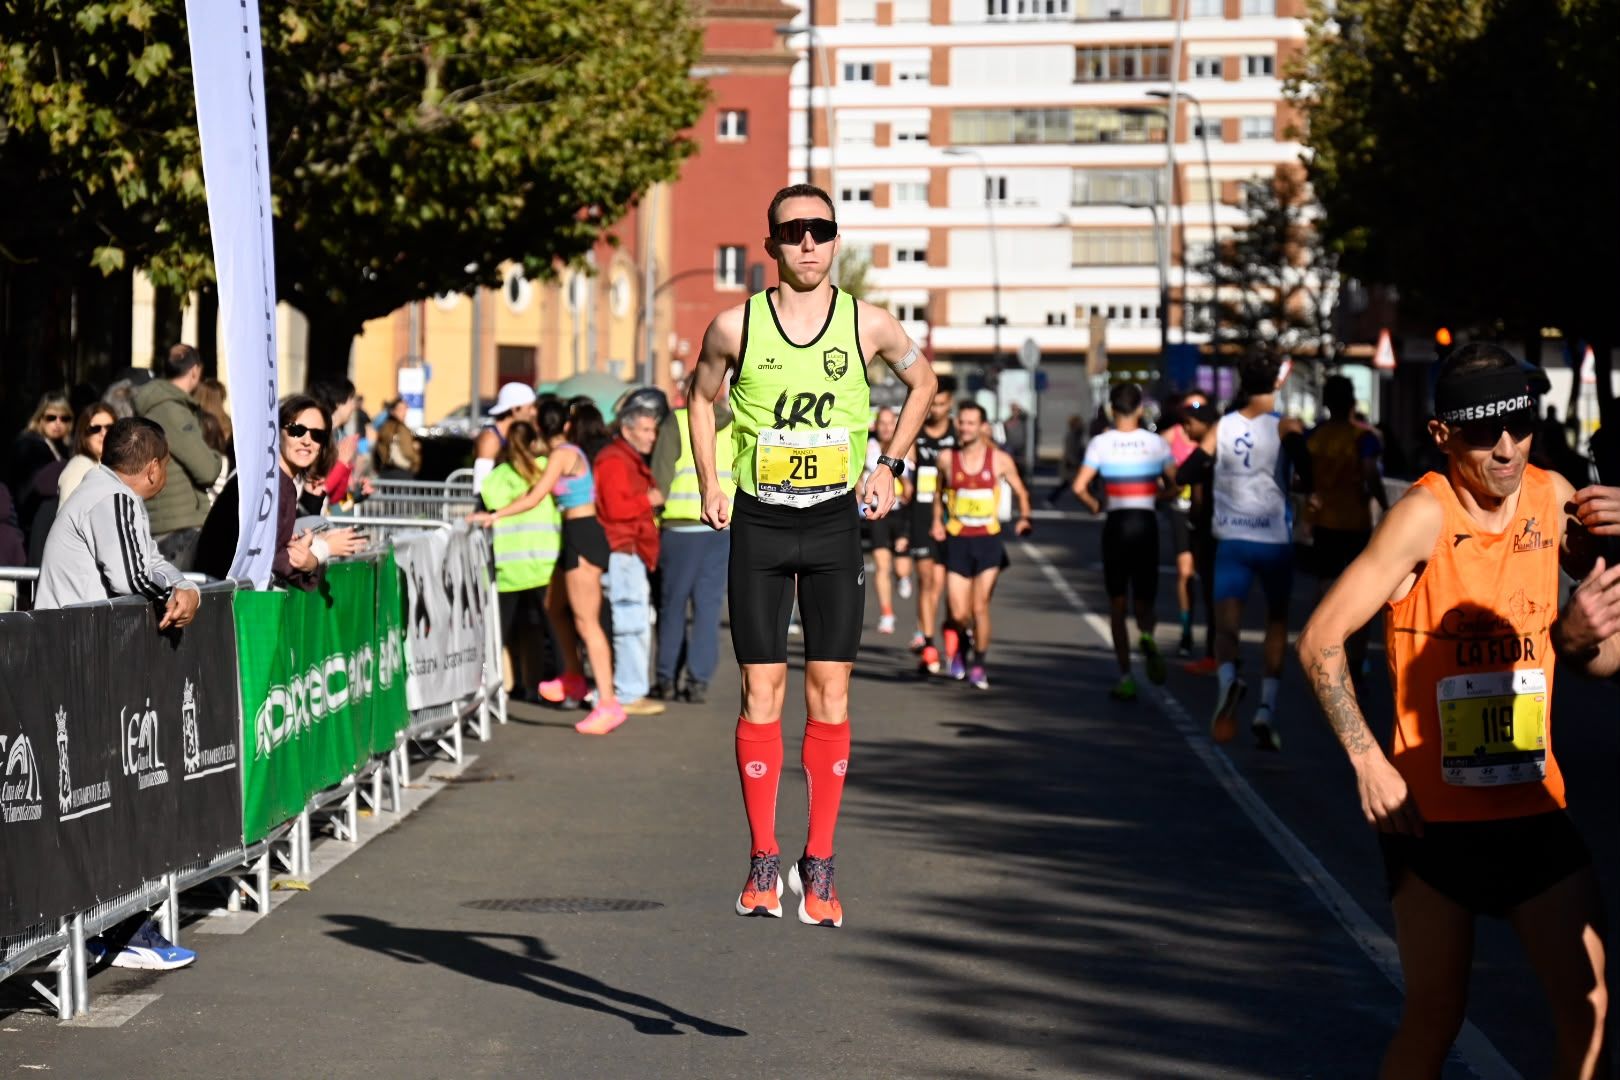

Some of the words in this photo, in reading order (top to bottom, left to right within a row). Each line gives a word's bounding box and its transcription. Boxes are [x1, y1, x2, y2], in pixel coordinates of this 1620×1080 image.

[789, 454, 818, 480] 26
[1456, 641, 1483, 667] LA
[1488, 637, 1536, 664] FLOR
[1482, 705, 1515, 743] 119
